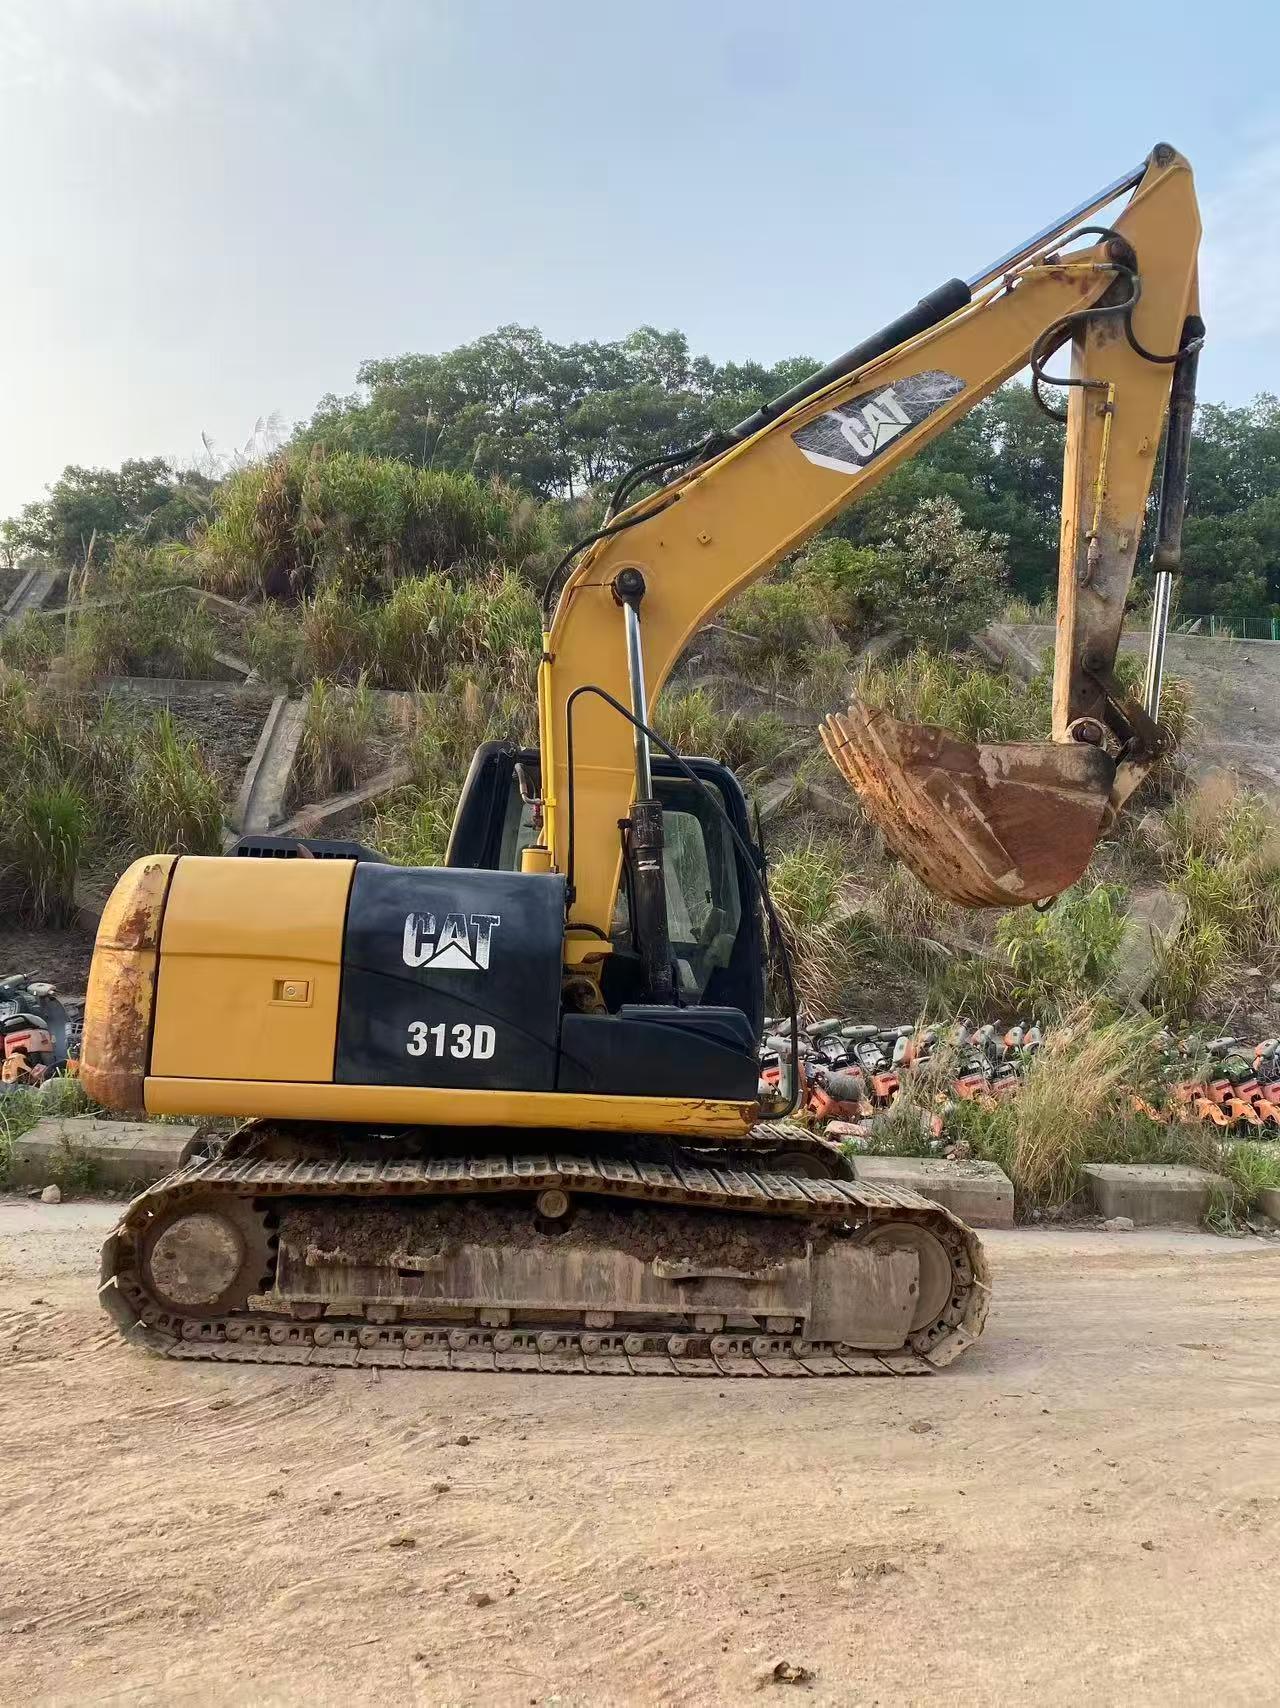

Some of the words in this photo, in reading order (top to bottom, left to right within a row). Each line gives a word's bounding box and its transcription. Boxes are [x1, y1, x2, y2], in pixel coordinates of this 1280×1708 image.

[840, 387, 913, 457] CAT
[402, 912, 500, 970] CAT
[406, 1021, 496, 1060] 313D
